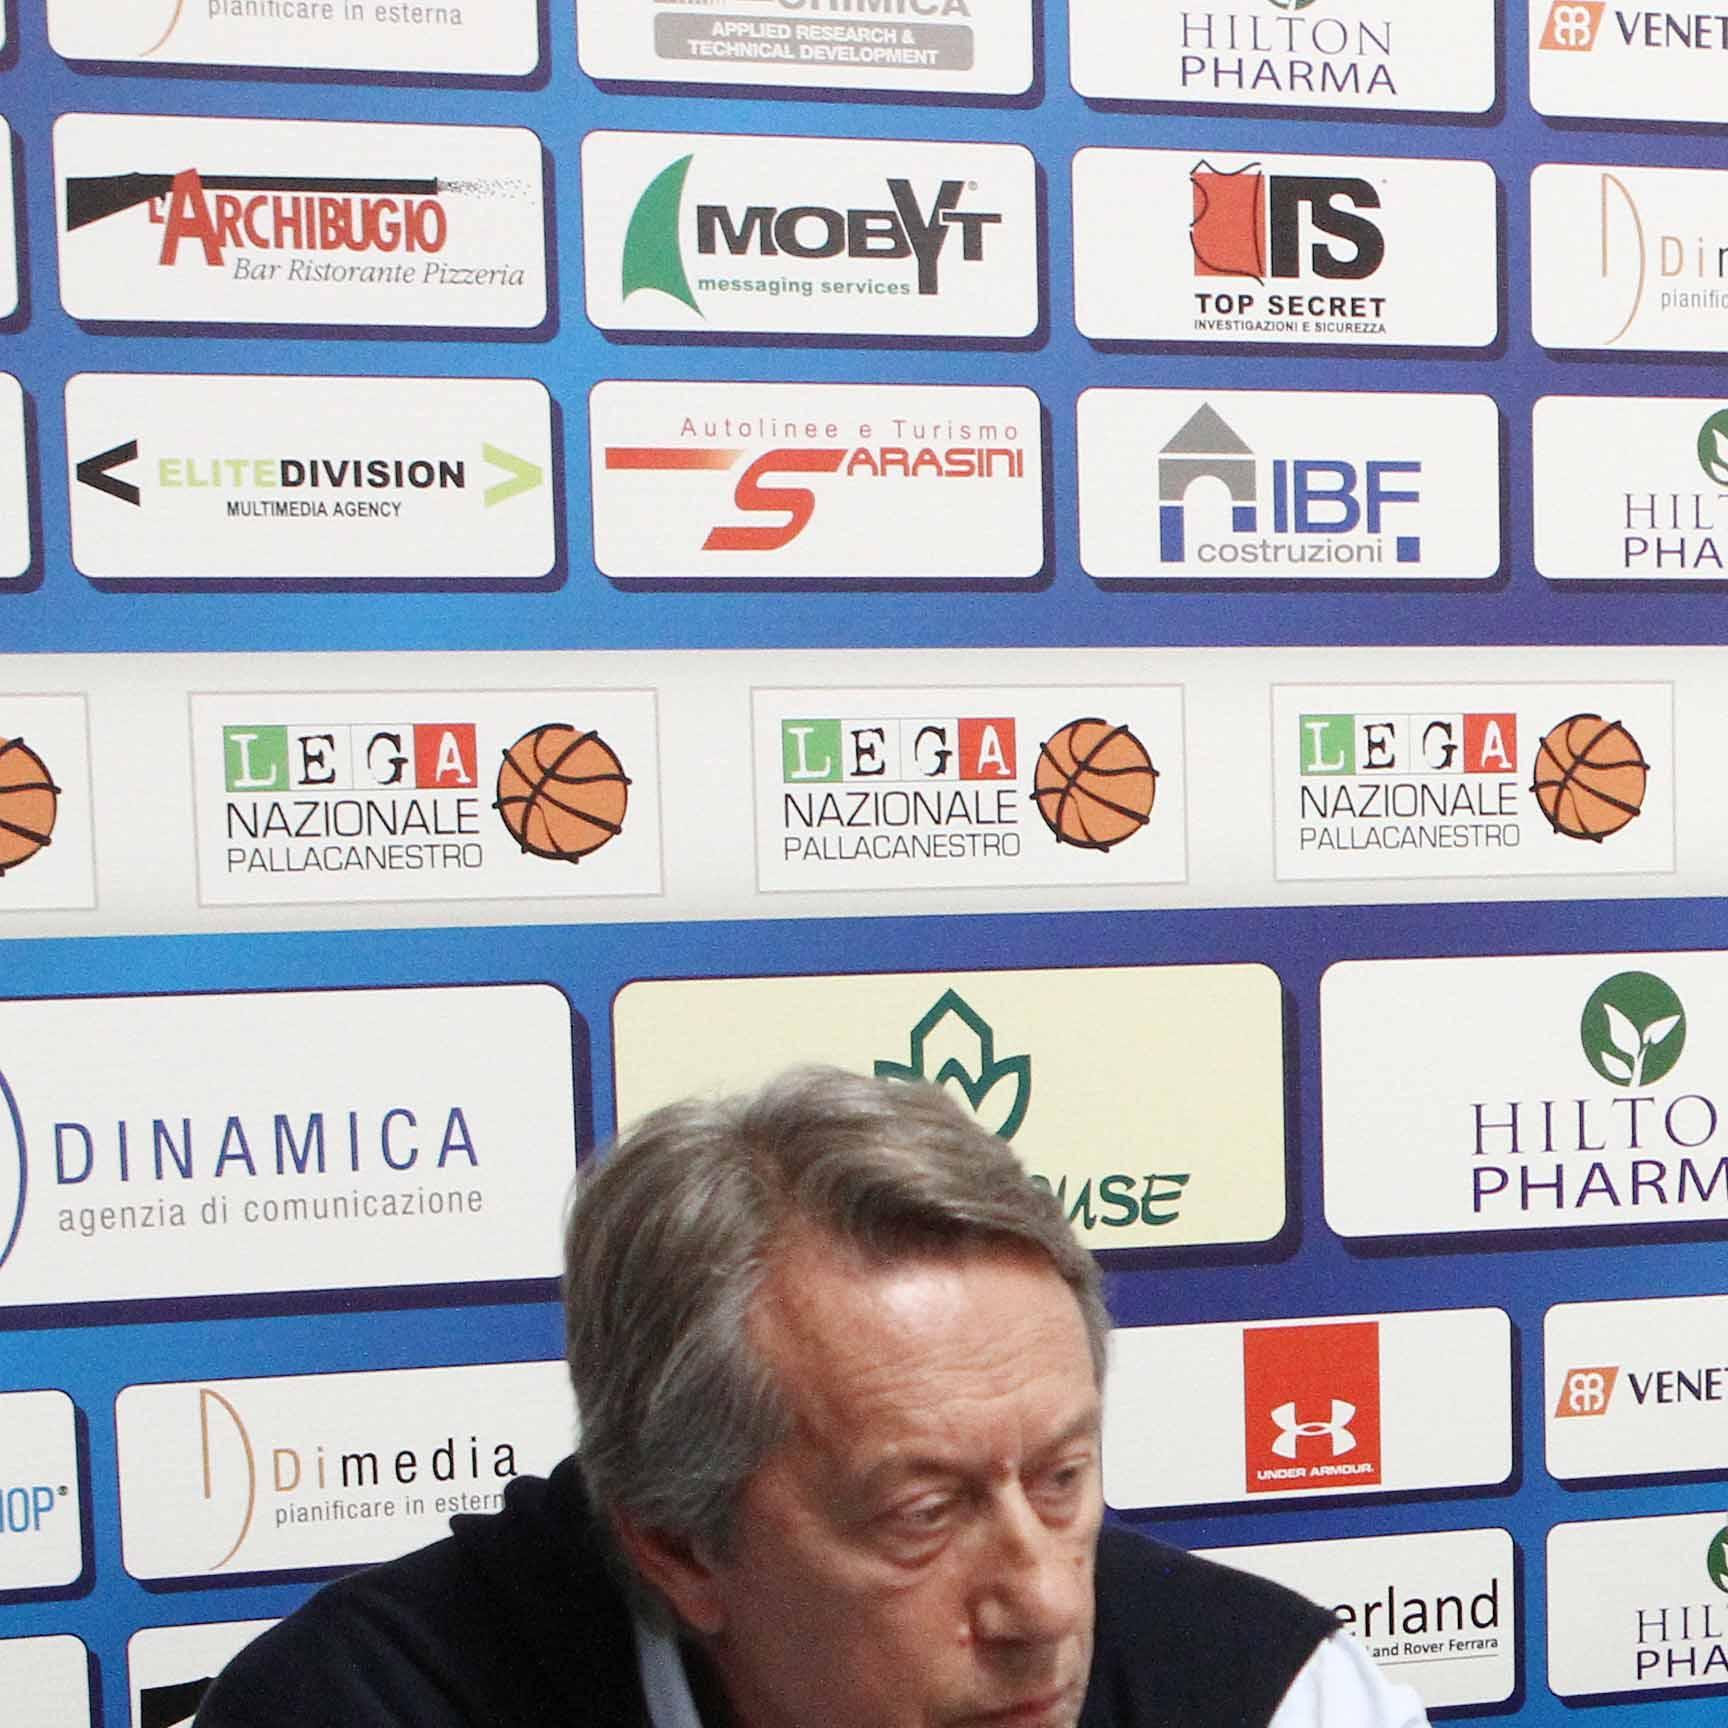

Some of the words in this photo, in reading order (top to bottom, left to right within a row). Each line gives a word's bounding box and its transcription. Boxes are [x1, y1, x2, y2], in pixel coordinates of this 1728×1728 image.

[375, 3, 463, 25] esterna
[711, 21, 790, 40] APPLIED
[796, 24, 896, 44] RESEARCH
[901, 28, 915, 45] &
[1180, 13, 1394, 56] HILTON
[688, 39, 793, 60] TECHNICAL
[800, 44, 938, 65] DEVELOPMENT
[1180, 56, 1398, 95] PHARMA
[233, 258, 282, 284] Bar
[287, 258, 414, 286] Ristorante
[421, 260, 524, 287] Pizzeria
[698, 275, 812, 296] messaging
[822, 278, 910, 295] services
[1195, 294, 1254, 314] TOP
[1268, 295, 1386, 317] SECRET
[1194, 320, 1298, 332] INVESTIGAZIONI
[1302, 322, 1310, 331] E
[1315, 322, 1386, 333] SICUREZZA
[681, 418, 844, 437] Autolinee
[860, 423, 872, 437] e
[894, 419, 1019, 441] Turismo
[227, 499, 327, 518] MULTIMEDIA
[333, 501, 401, 518] AGENCY
[1273, 460, 1421, 535] IBF
[1197, 535, 1382, 565] costruzioni
[223, 723, 477, 791] LEGA
[782, 718, 1016, 783] LEGA
[1299, 713, 1517, 774] LEGA
[784, 790, 1018, 829] NAZIONALE
[1301, 780, 1518, 818] NAZIONALE
[226, 798, 479, 839] NAZIONALE
[784, 832, 1020, 861] PALLACANESTRO
[1300, 822, 1520, 851] PALLACANESTRO
[227, 842, 483, 873] PALLACANESTRO
[53, 1105, 480, 1188] DINAMICA
[58, 1196, 186, 1236] agenzia
[200, 1195, 230, 1226] di
[244, 1187, 483, 1226] comunicazione
[273, 1436, 519, 1492] Dimedia
[1257, 1467, 1306, 1480] UNDER
[275, 1499, 395, 1527] pianificare
[406, 1496, 425, 1516] in
[435, 1494, 506, 1513] estern
[1404, 1641, 1444, 1655] Rover
[1449, 1637, 1498, 1652] Ferrara
